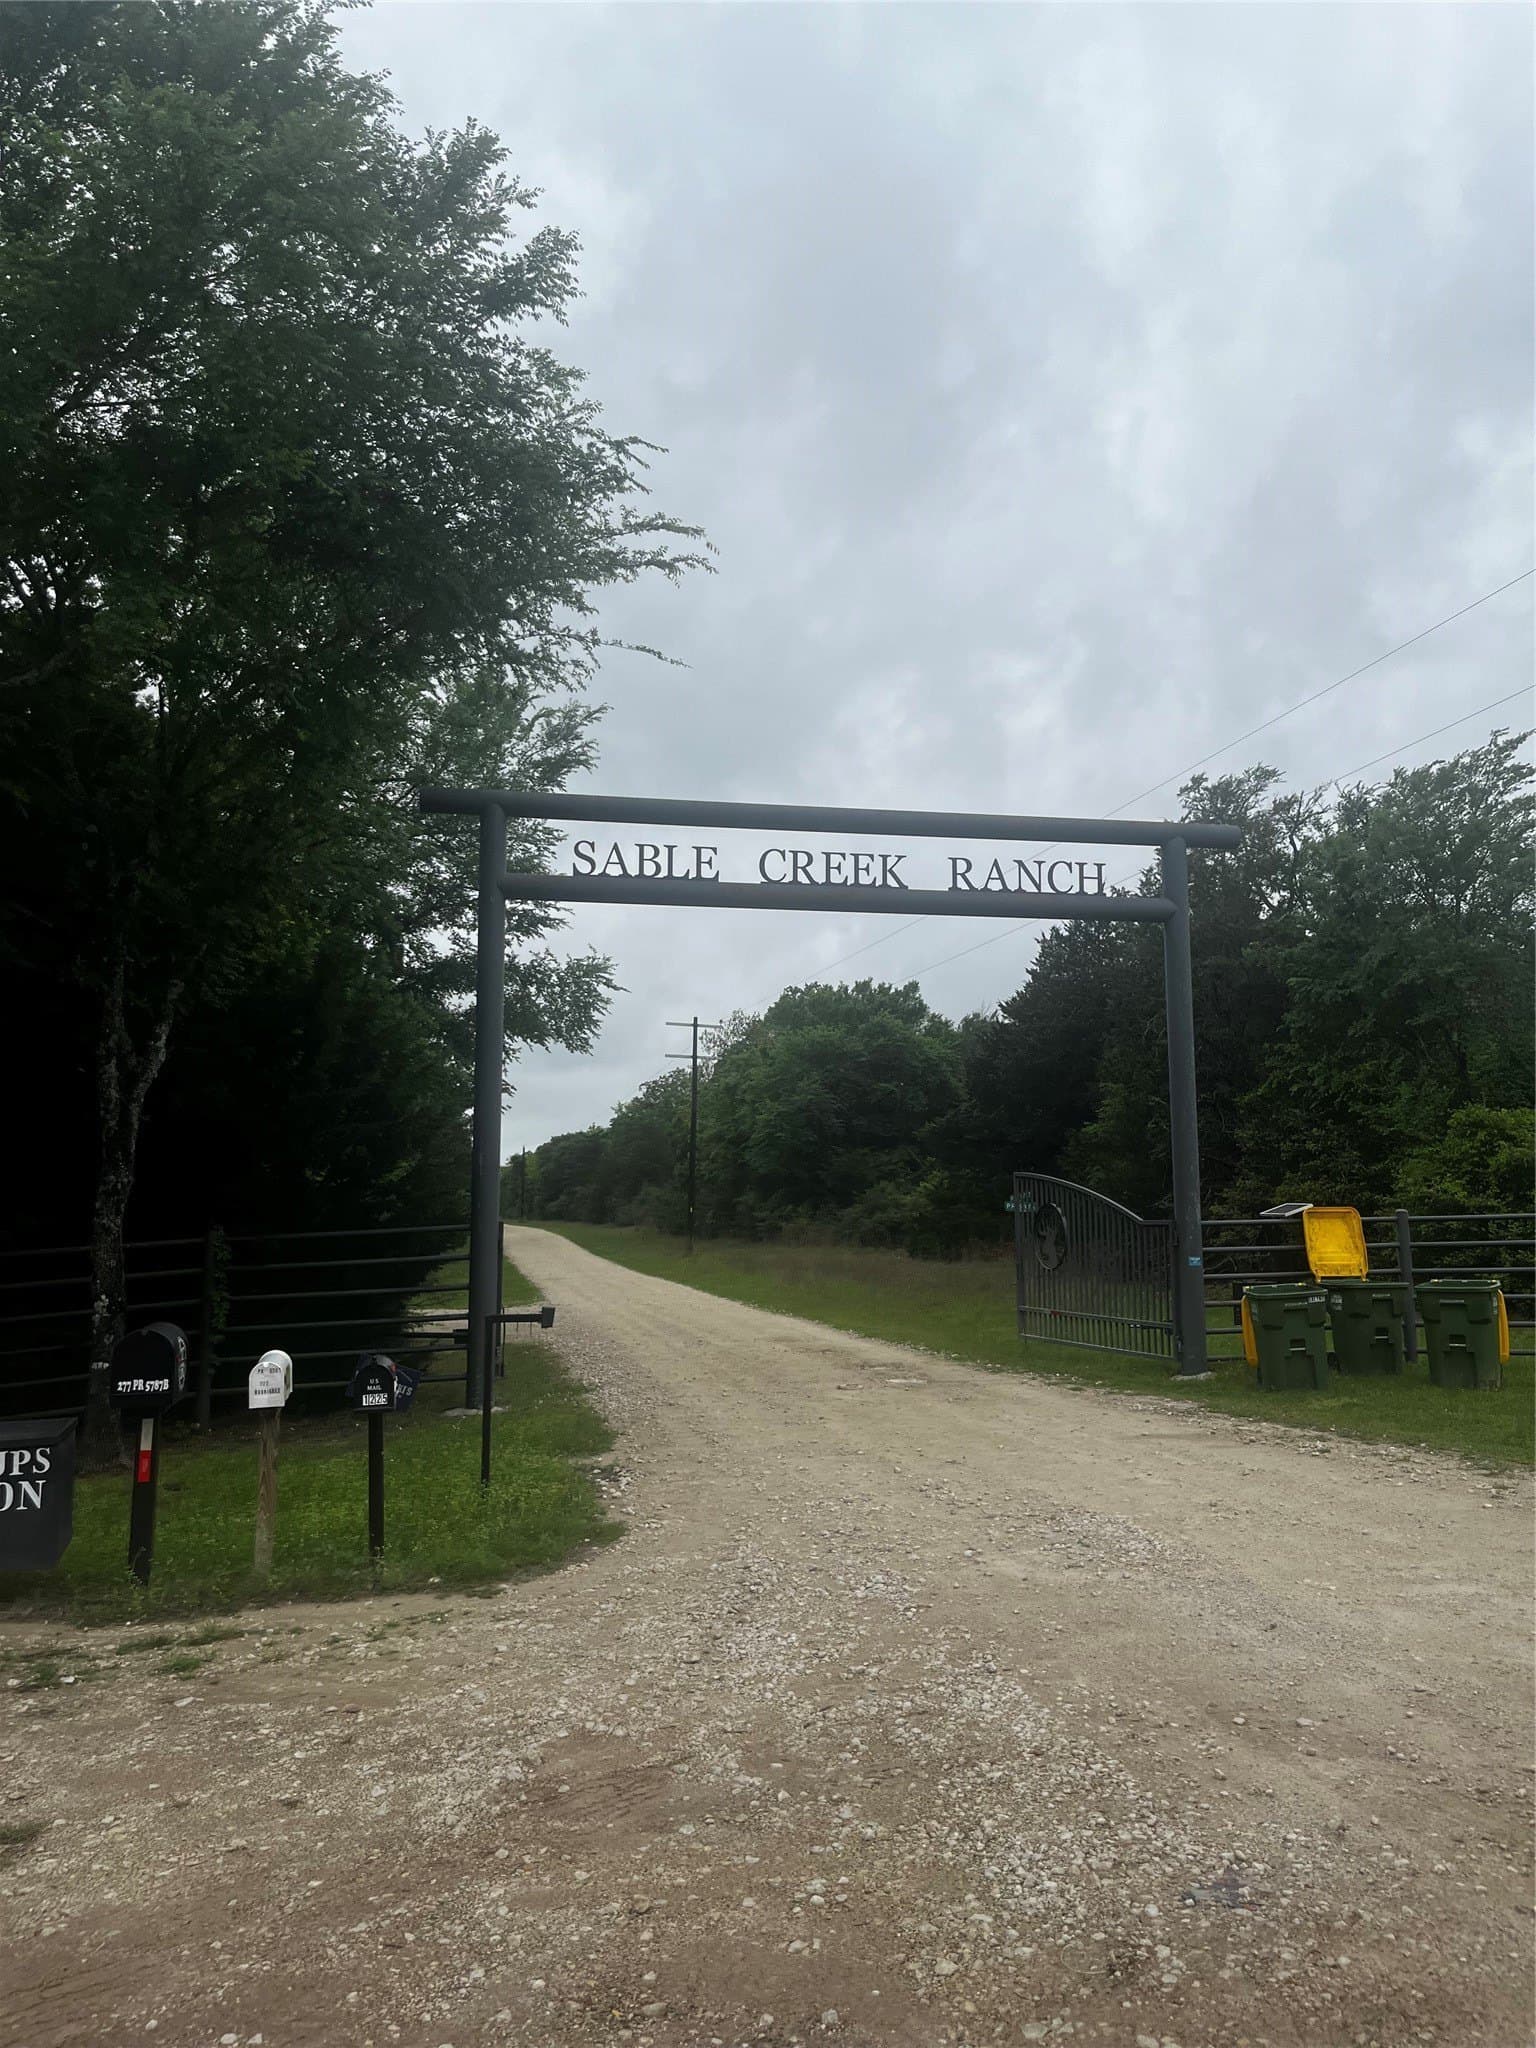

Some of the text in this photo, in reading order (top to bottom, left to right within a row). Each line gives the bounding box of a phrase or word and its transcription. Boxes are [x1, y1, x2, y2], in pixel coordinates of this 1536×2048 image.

[573, 840, 1107, 896] SABLE CREEK RANCH
[133, 1379, 144, 1390] PR
[363, 1393, 388, 1406] 1225
